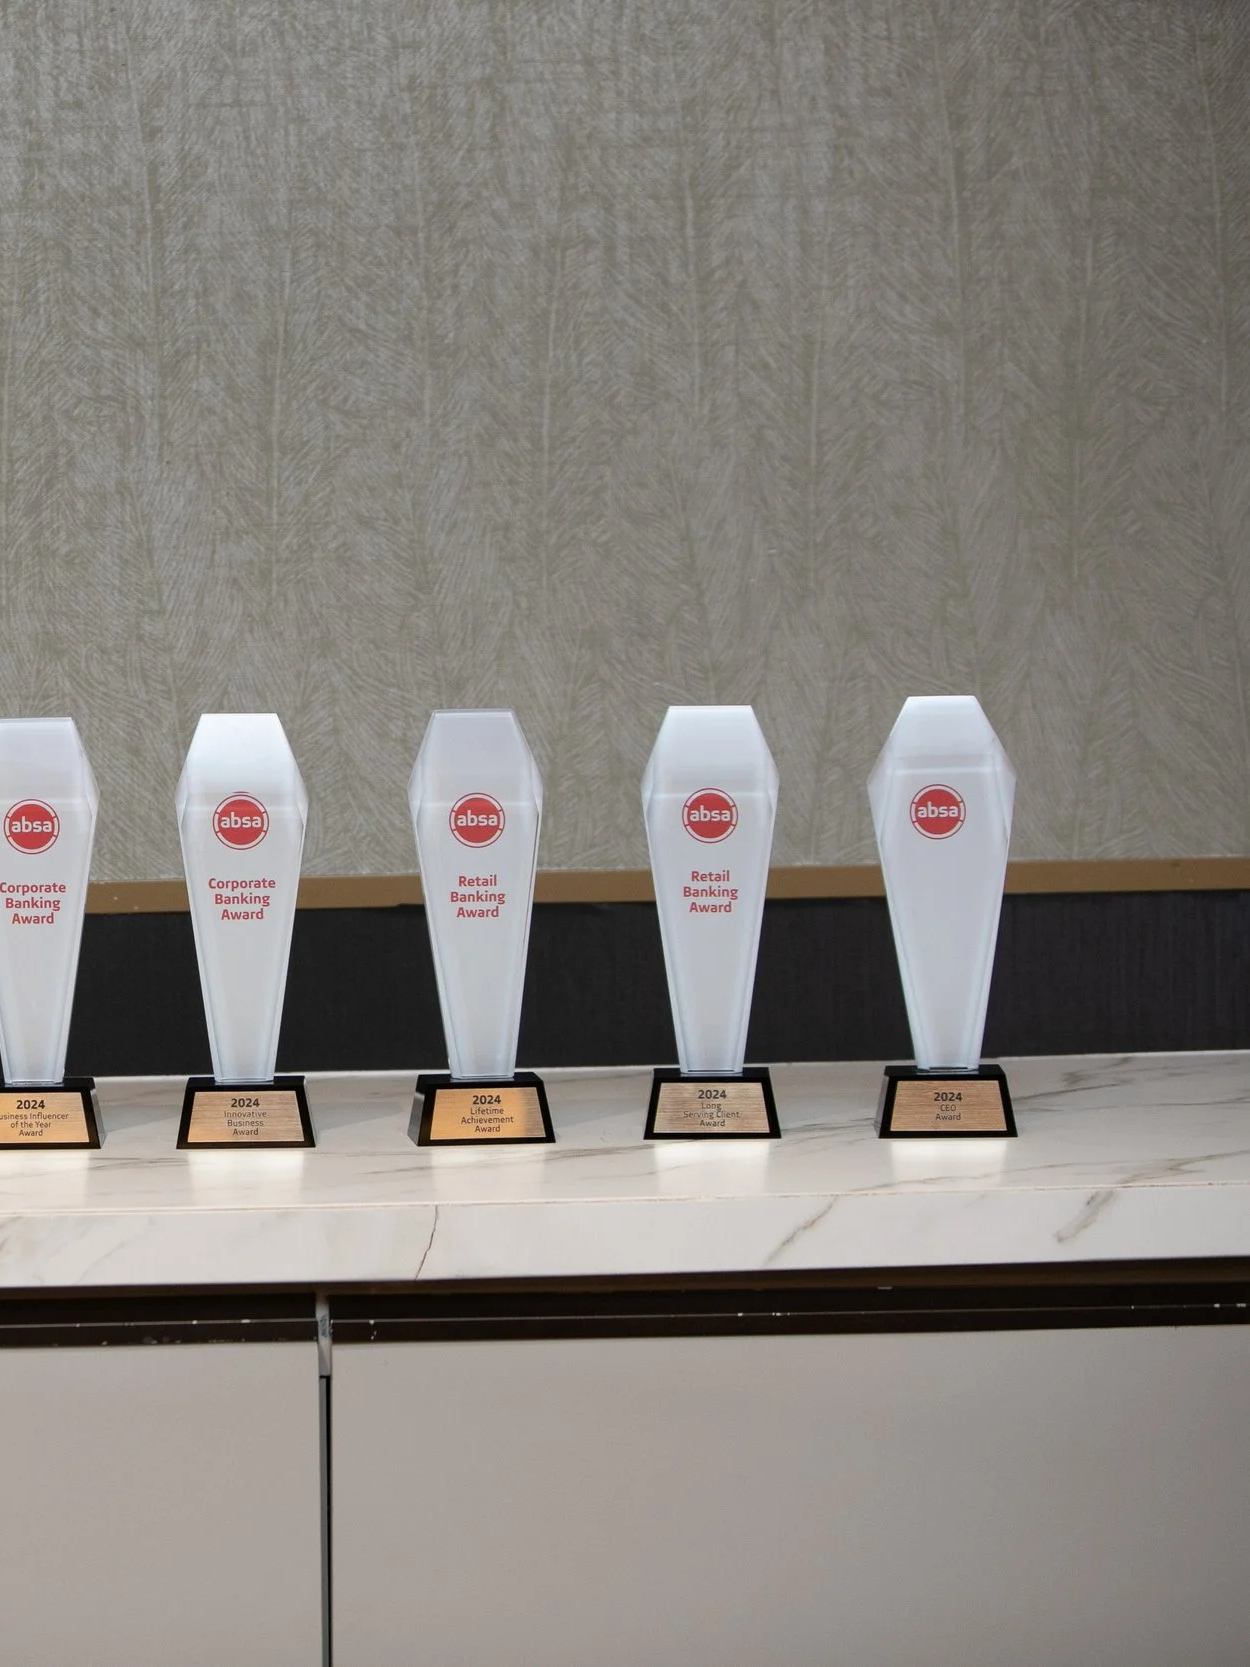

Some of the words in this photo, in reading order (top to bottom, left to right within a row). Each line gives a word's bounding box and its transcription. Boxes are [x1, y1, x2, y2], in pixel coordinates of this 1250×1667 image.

[690, 805, 731, 822] absa
[917, 802, 959, 818] absa
[220, 812, 262, 828] absa
[457, 810, 499, 827] absa
[11, 817, 53, 834] absa
[458, 874, 498, 887] Retail
[691, 869, 730, 882] Retail
[0, 881, 66, 896] Corporate
[208, 876, 276, 891] Corporate
[450, 889, 506, 905] Banking
[683, 884, 738, 900] Banking
[5, 897, 61, 912] Banking
[215, 892, 270, 907] Banking
[689, 900, 732, 912] Award
[221, 907, 264, 920] Award
[456, 905, 499, 918] Award
[12, 911, 55, 923] Award
[472, 1095, 501, 1105] 2024
[697, 1090, 727, 1100] 2024
[933, 1092, 963, 1102] 2024
[16, 1100, 45, 1110] 2024
[231, 1098, 260, 1108] 2024
[701, 1102, 722, 1111] Long
[940, 1104, 957, 1112] CEO
[224, 1110, 267, 1119] Innovative
[470, 1106, 504, 1115] Lifetime
[683, 1111, 714, 1120] Serving
[716, 1110, 739, 1118] Client
[29, 1112, 68, 1120] Influencer
[461, 1116, 514, 1124] Achievement
[935, 1112, 961, 1121] Award
[10, 1121, 18, 1129] of
[19, 1121, 33, 1129] the
[34, 1121, 51, 1129] Year
[227, 1119, 264, 1127] Business
[700, 1119, 725, 1127] Award
[19, 1129, 43, 1137] Award
[232, 1127, 259, 1136] Award
[474, 1124, 500, 1133] Award
